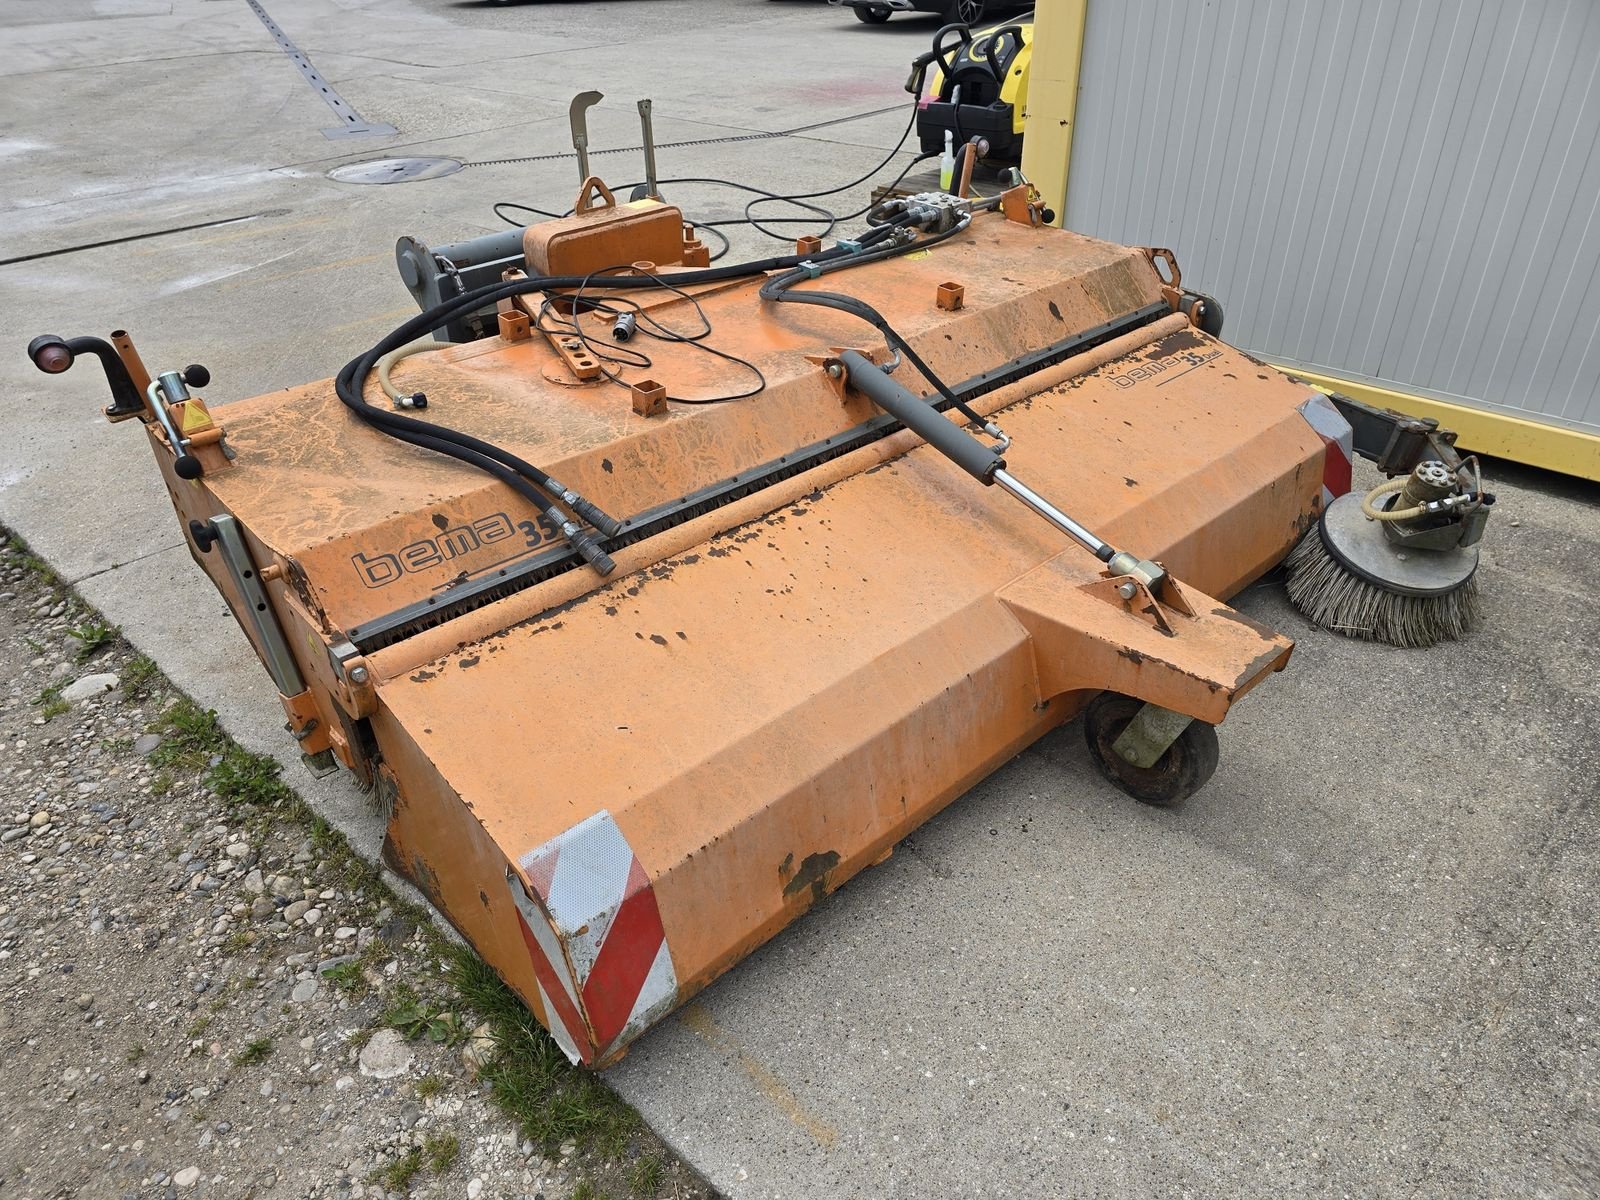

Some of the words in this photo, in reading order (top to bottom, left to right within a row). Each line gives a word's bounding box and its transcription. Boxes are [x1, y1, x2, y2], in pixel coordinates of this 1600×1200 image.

[1105, 356, 1181, 389] bema
[1180, 352, 1204, 367] 35
[351, 512, 516, 588] bema
[517, 514, 558, 547] 35
